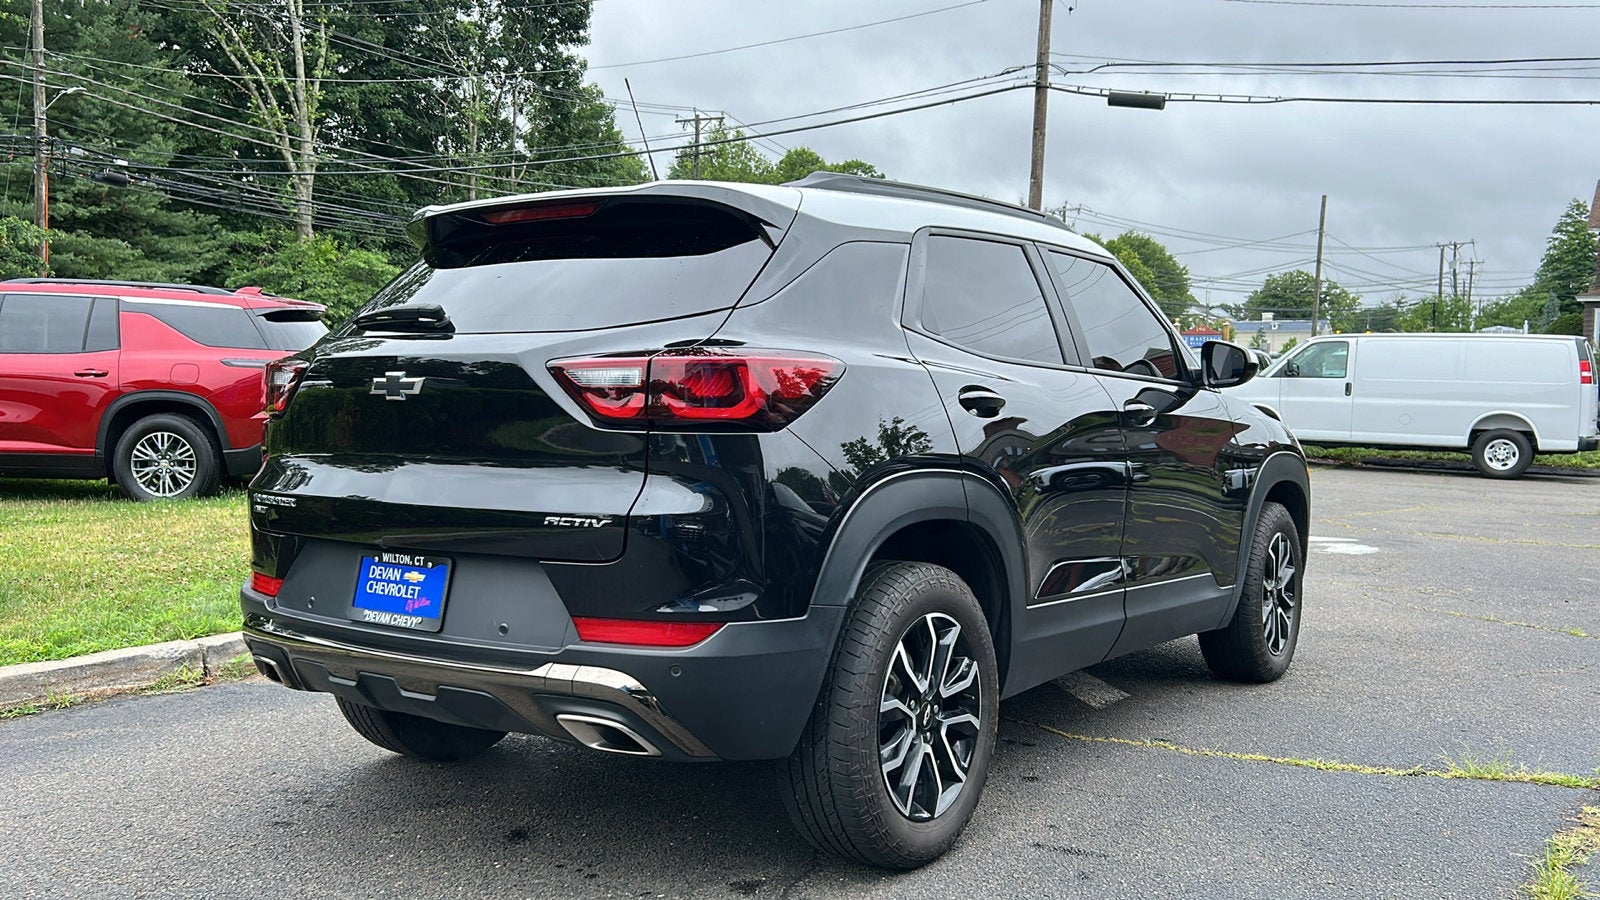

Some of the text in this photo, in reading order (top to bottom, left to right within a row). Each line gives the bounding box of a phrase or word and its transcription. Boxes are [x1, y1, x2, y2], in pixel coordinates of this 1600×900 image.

[543, 516, 613, 528] ACTIV
[382, 552, 425, 567] WILTON, CT
[369, 565, 402, 581] DEVAN
[366, 580, 421, 599] CHEVROLET
